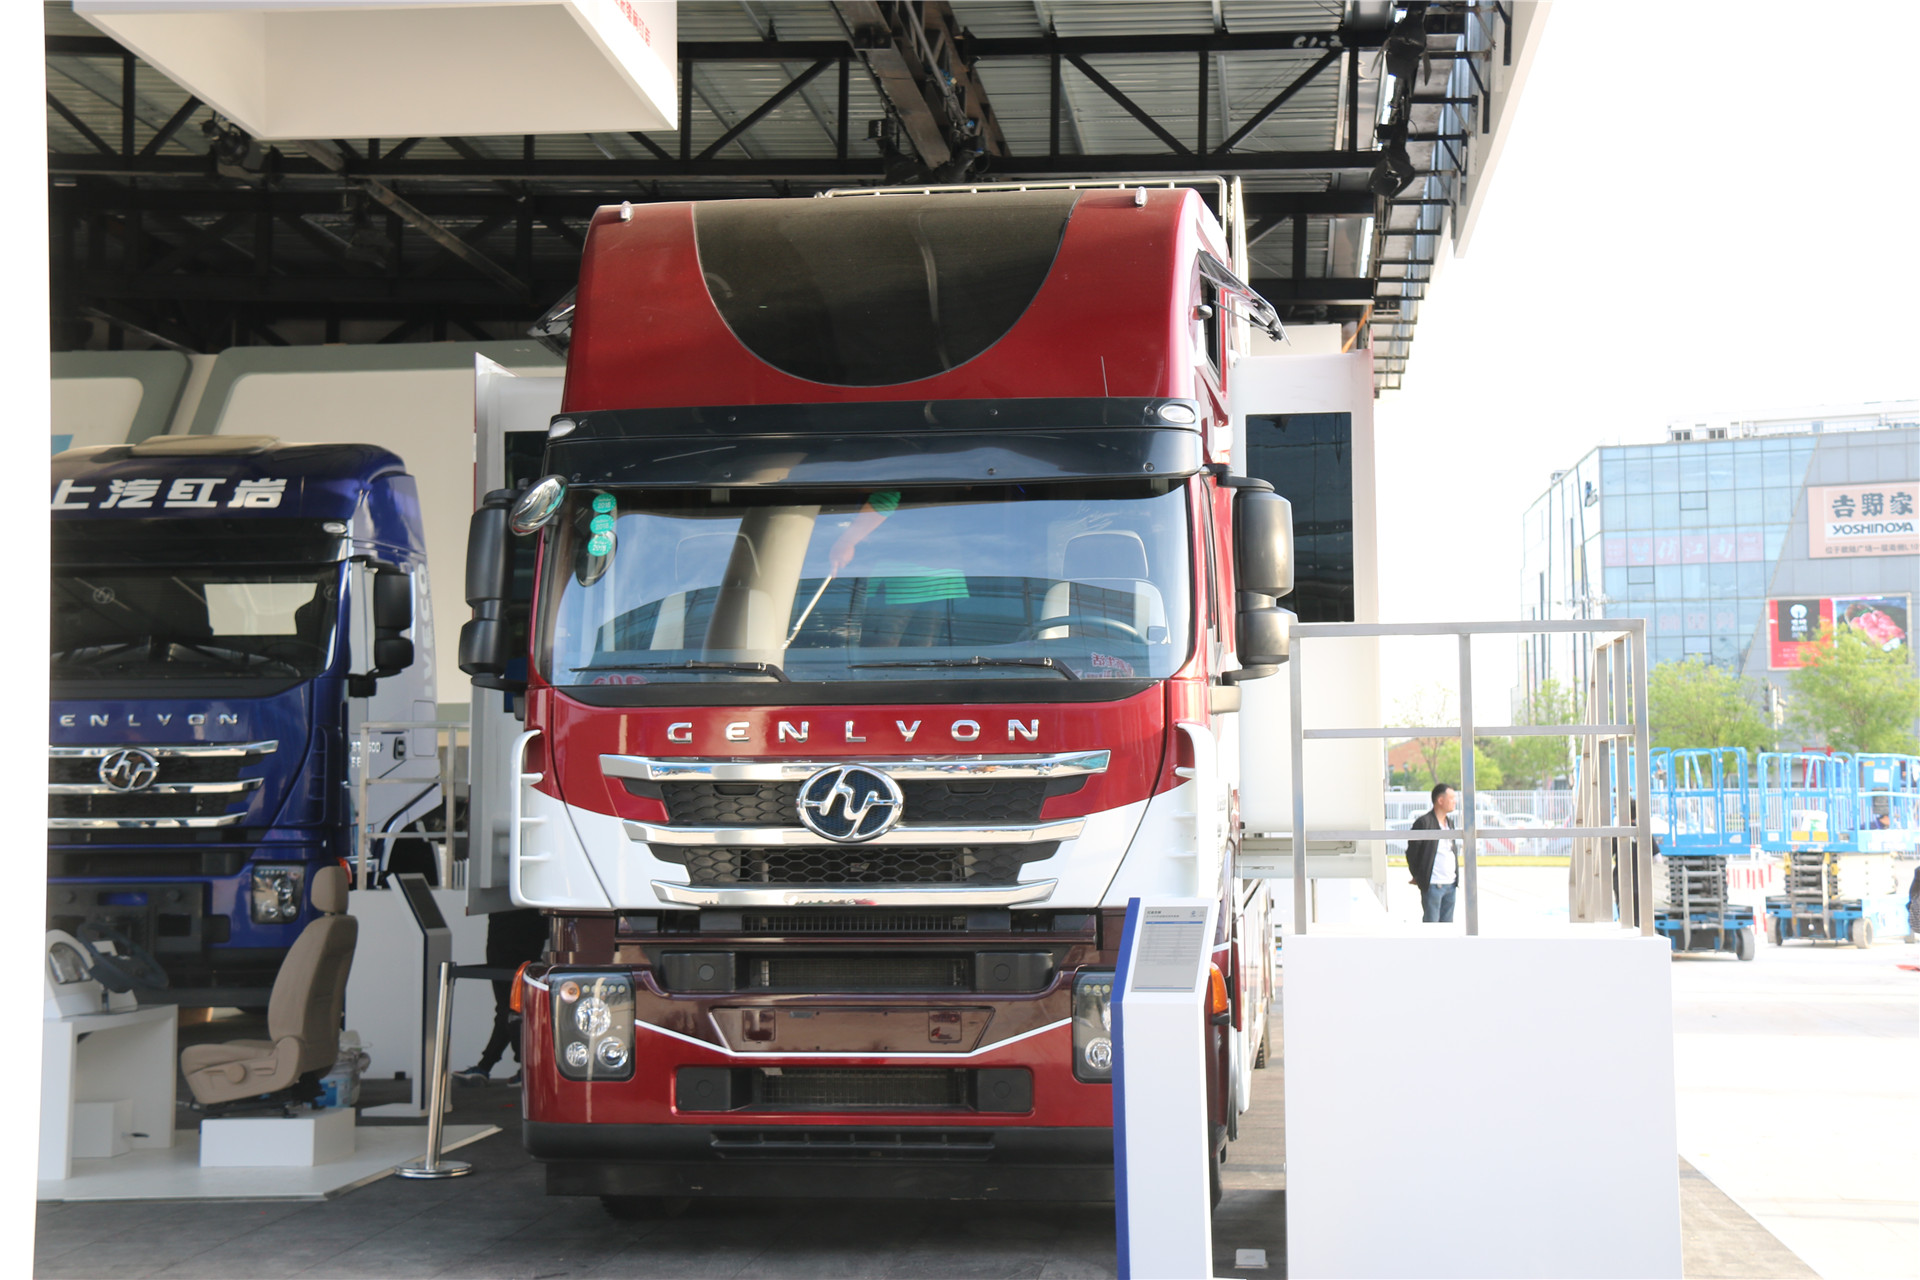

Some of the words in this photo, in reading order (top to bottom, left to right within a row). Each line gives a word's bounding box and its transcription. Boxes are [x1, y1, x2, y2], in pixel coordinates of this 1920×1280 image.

[51, 478, 288, 510] 上汽红岩
[1831, 491, 1914, 519] 吉野家
[1832, 521, 1914, 535] YOSHINOYA
[418, 562, 433, 698] IVECO
[667, 719, 1040, 743] GENLYON
